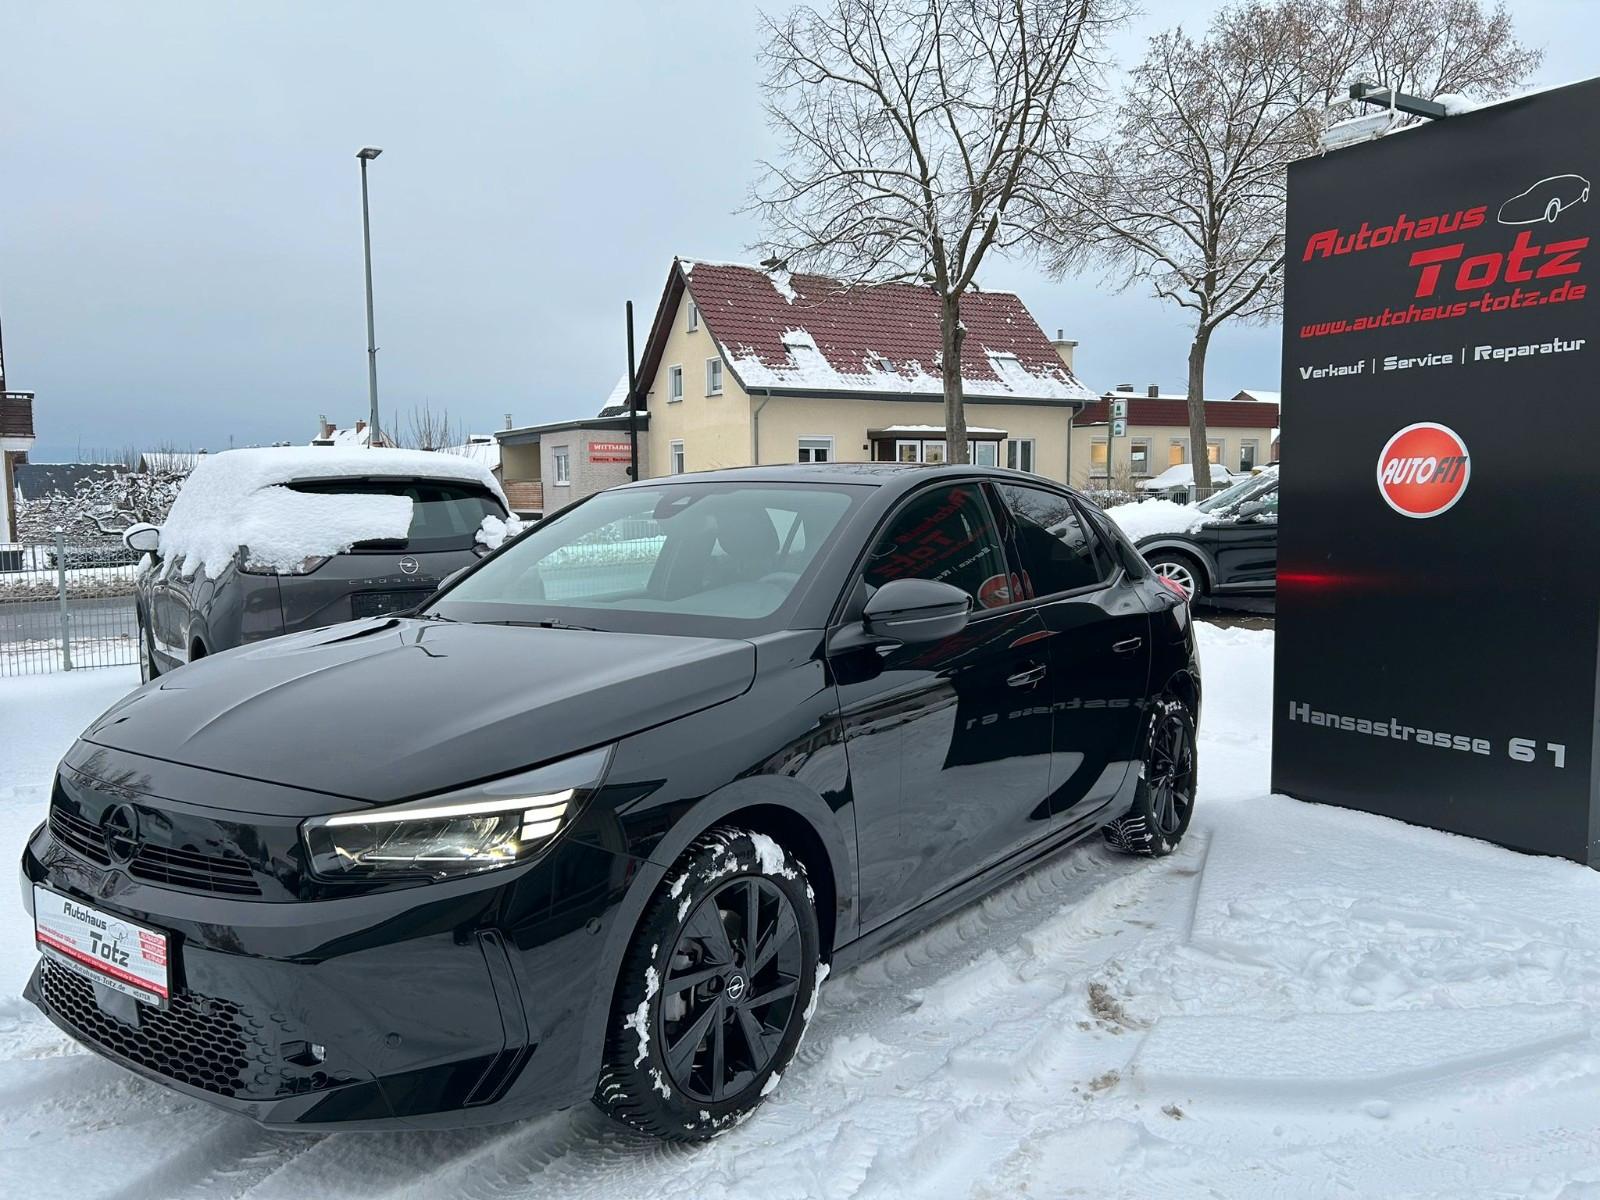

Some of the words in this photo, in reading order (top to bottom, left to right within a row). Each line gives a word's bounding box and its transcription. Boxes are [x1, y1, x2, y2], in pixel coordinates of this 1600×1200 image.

[1302, 205, 1488, 263] Autohaus
[1408, 231, 1590, 298] Totz
[1300, 280, 1588, 339] www.autohaus-totz.de
[1299, 360, 1366, 381] Verkauf
[1384, 352, 1453, 371] Service
[1474, 337, 1586, 362] Reparatur
[1381, 455, 1468, 485] AUTOFIT
[1289, 701, 1491, 756] Hansastrasse
[1508, 737, 1565, 768] 61
[63, 901, 107, 930] Autohaus
[89, 930, 130, 967] Totz
